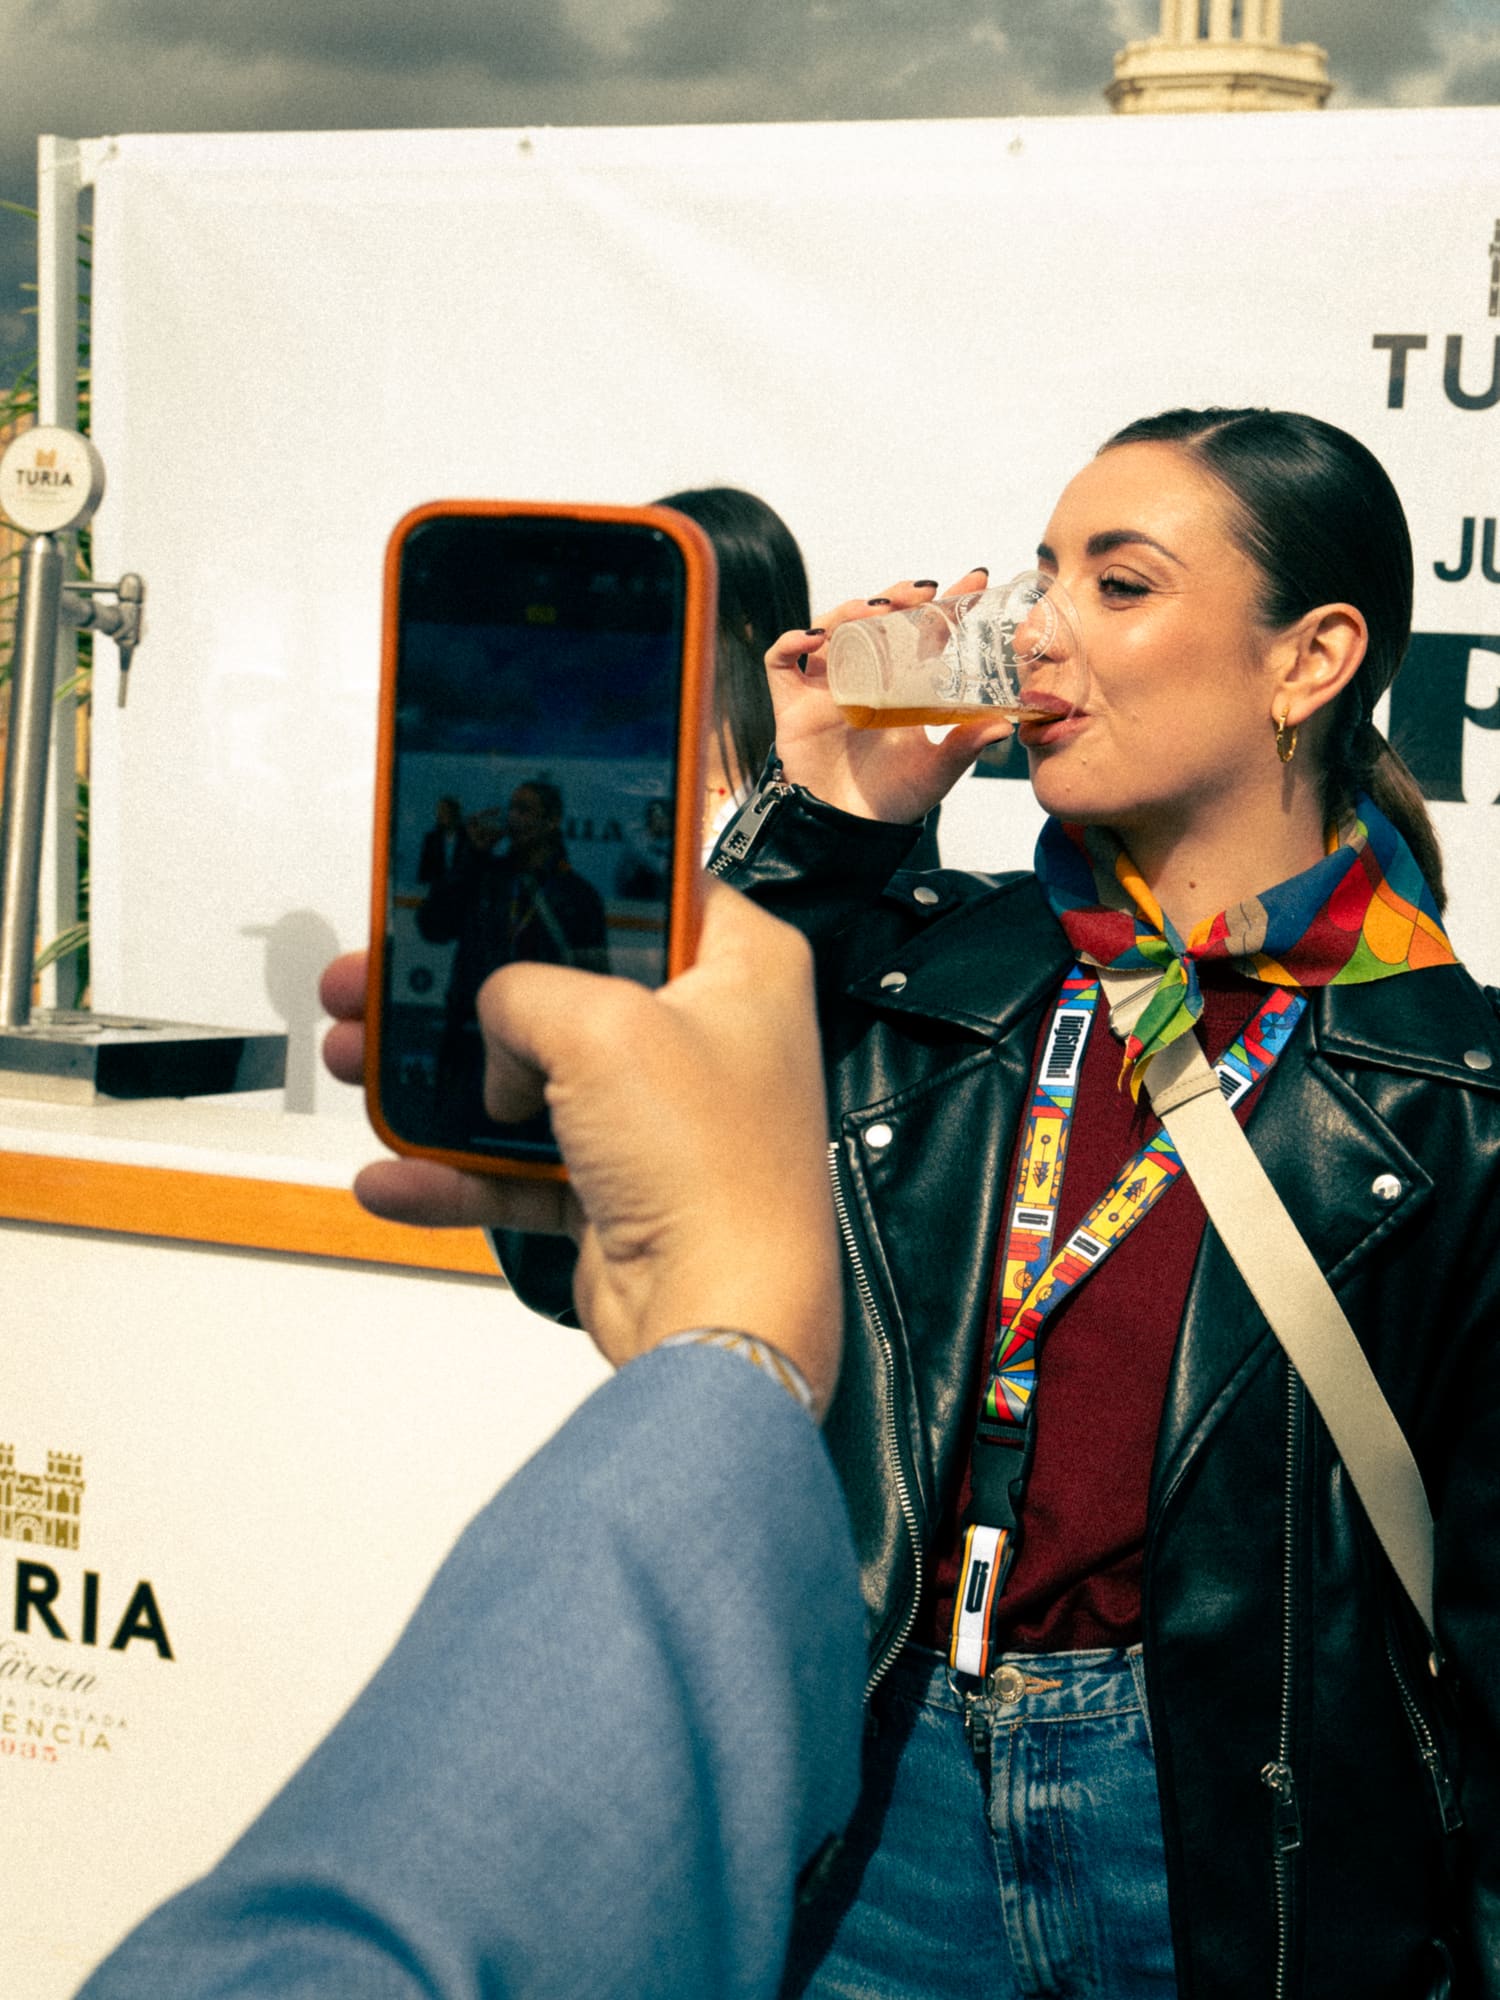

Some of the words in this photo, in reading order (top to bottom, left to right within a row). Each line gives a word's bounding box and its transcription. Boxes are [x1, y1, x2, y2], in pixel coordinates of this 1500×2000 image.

[1372, 334, 1500, 411] TU
[16, 469, 73, 487] TURIA
[14, 1558, 176, 1661] RIA
[0, 1643, 97, 1694] ärzen
[2, 1712, 112, 1753] ENCIA
